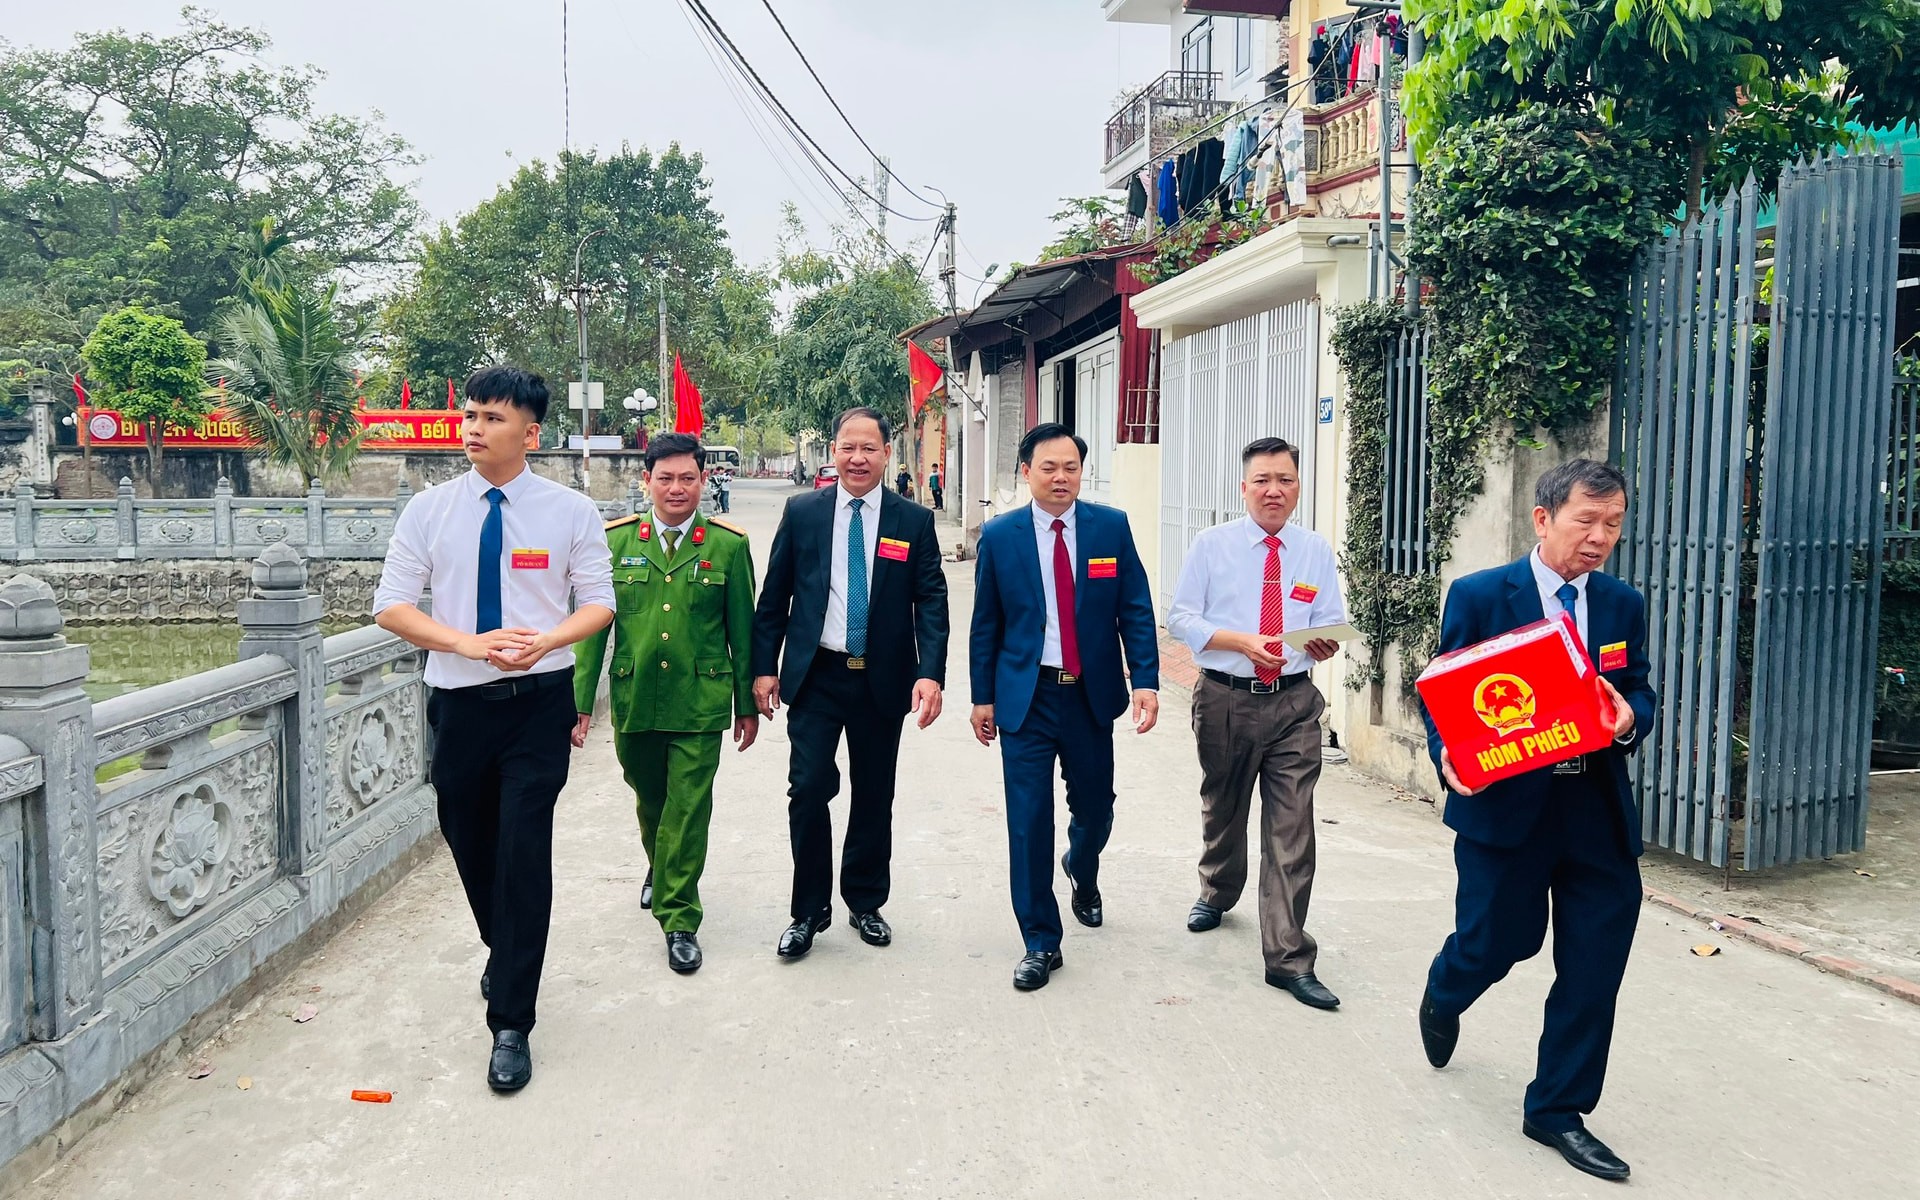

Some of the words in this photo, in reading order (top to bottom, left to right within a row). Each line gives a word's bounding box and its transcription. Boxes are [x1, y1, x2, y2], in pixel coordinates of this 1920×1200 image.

[121, 420, 139, 437] DI
[421, 417, 450, 439] BỐI
[1476, 743, 1523, 773] HÒM
[1521, 718, 1581, 758] PHIẾU
